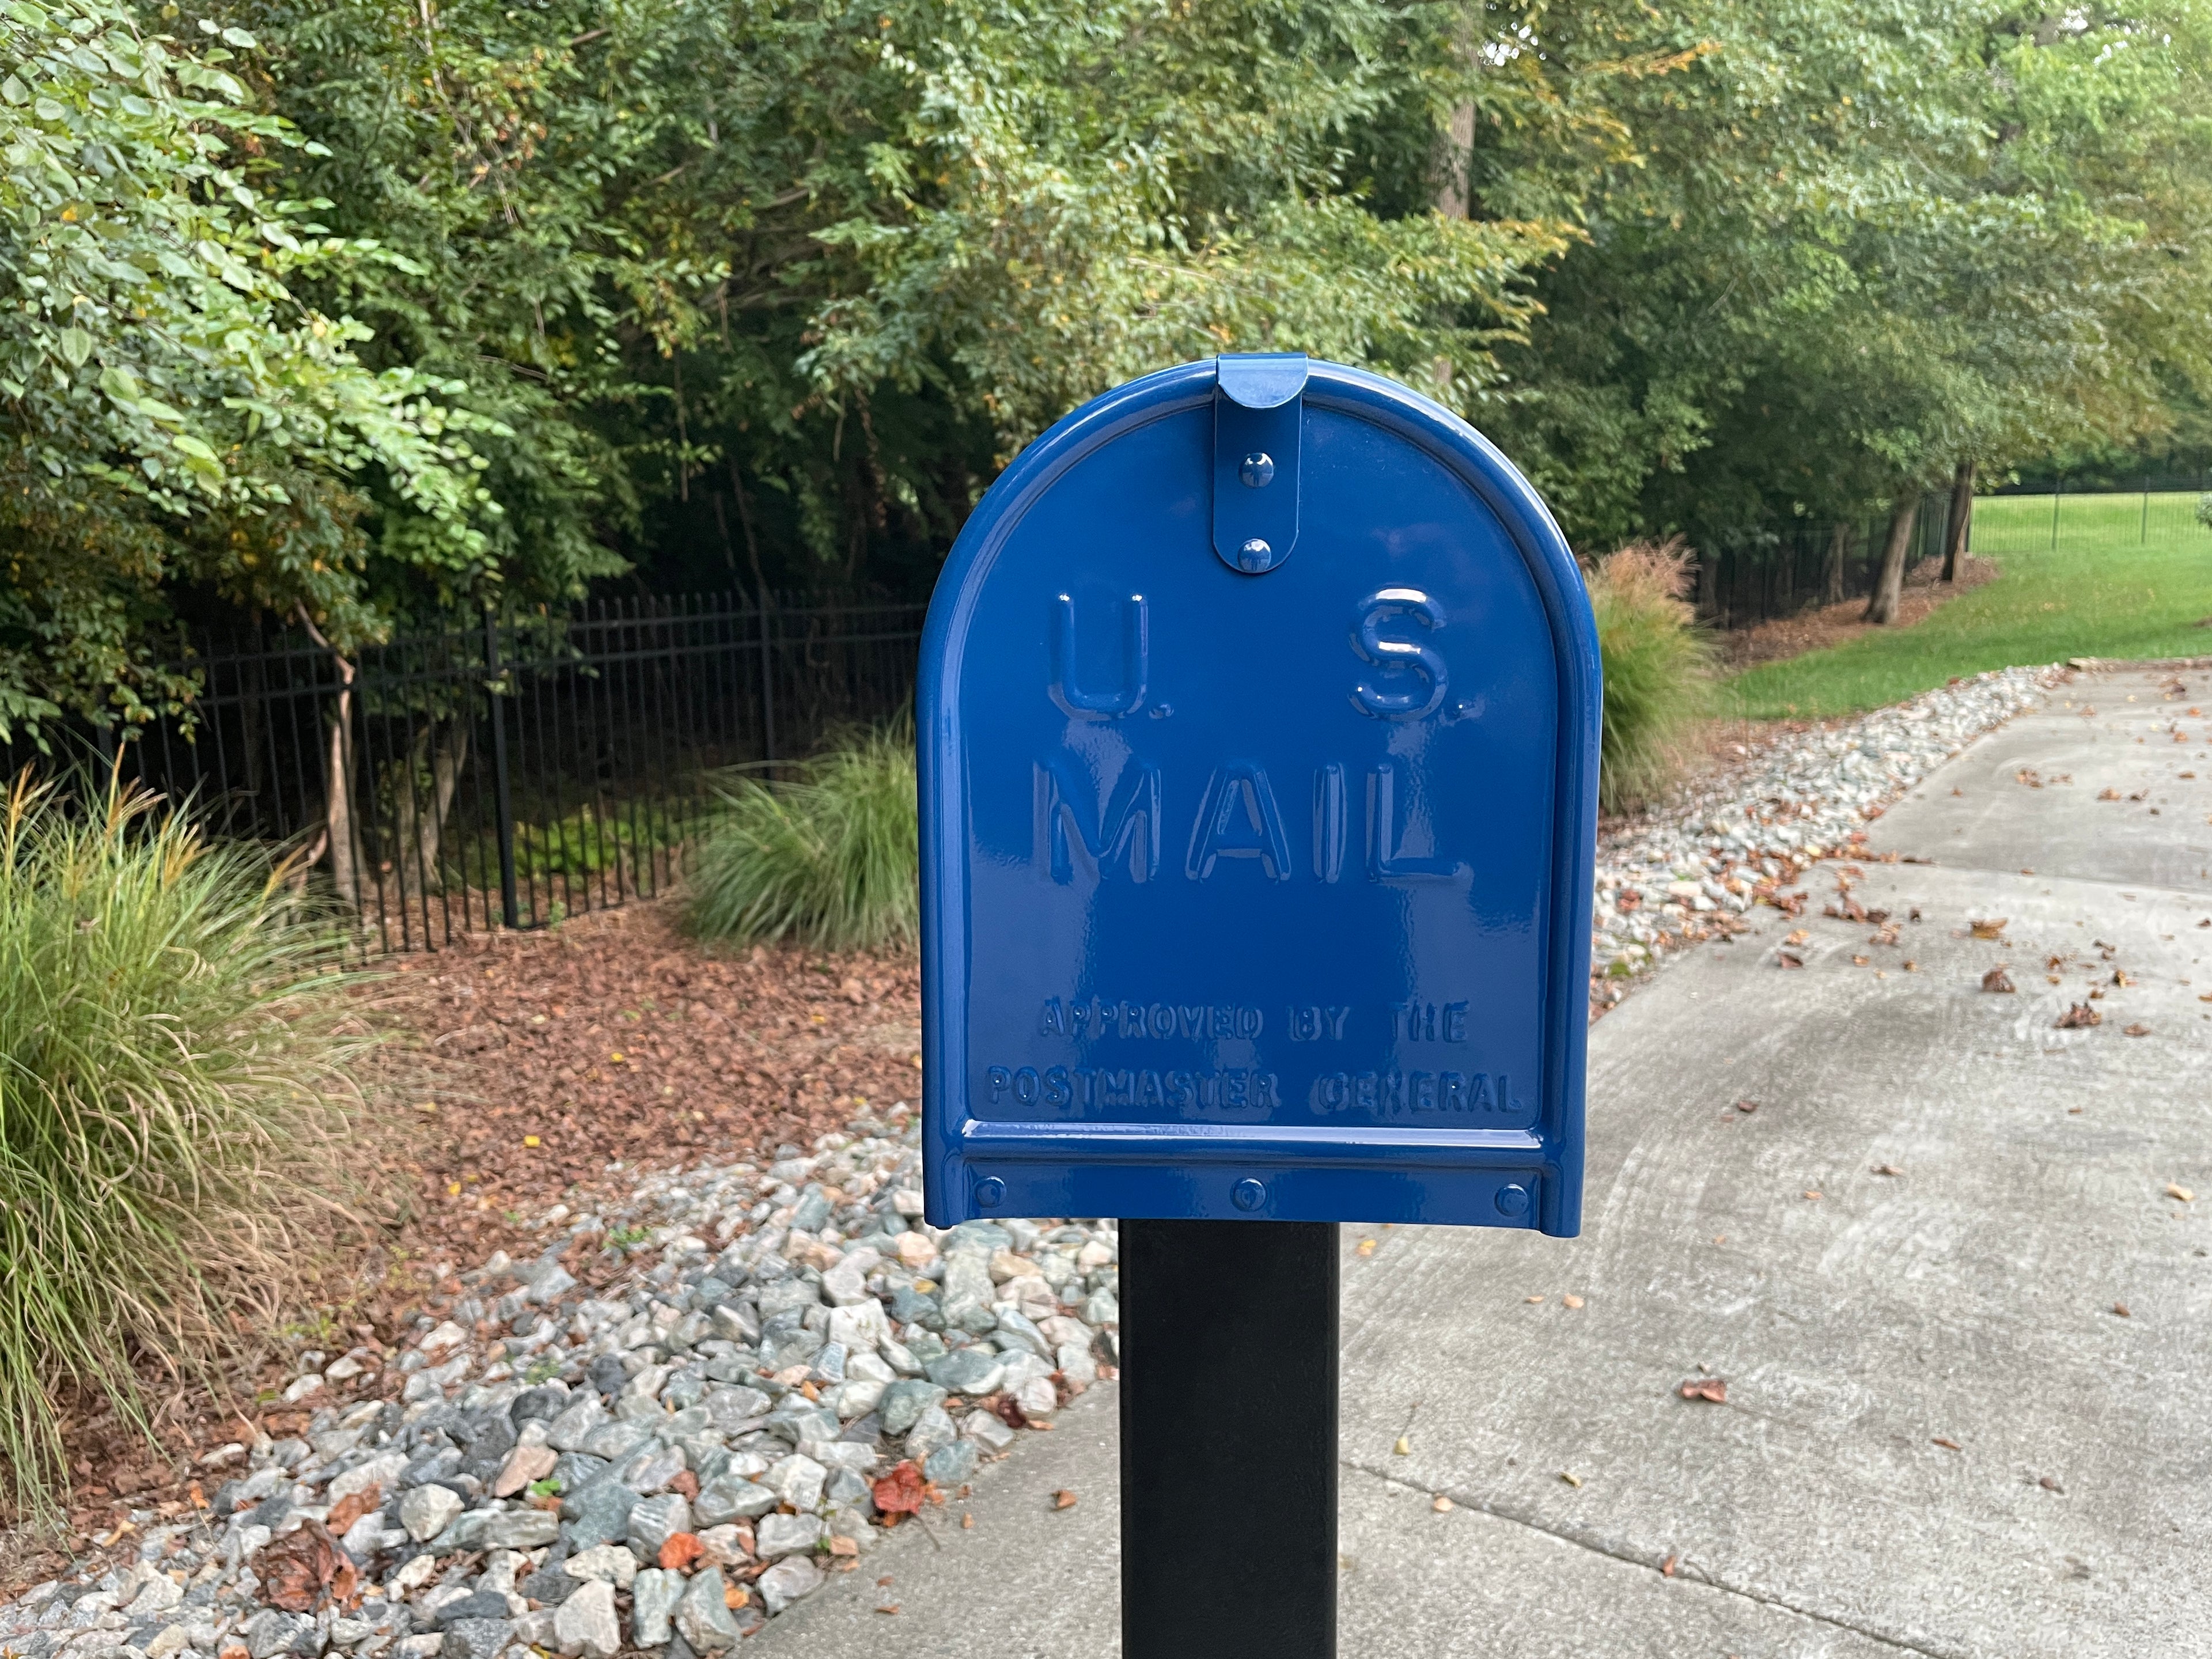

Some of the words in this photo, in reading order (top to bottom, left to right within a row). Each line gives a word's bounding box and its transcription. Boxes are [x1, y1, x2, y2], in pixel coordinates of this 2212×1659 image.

[1048, 593, 1174, 721] U.
[1349, 587, 1485, 722] S.
[1035, 762, 1475, 885] MAIL
[1041, 997, 1263, 1039] APPROVED
[1288, 1005, 1350, 1041] BY
[1391, 1001, 1470, 1043] THE
[987, 1066, 1281, 1109] POSTMASTER
[1310, 1070, 1524, 1113] GENERAL
